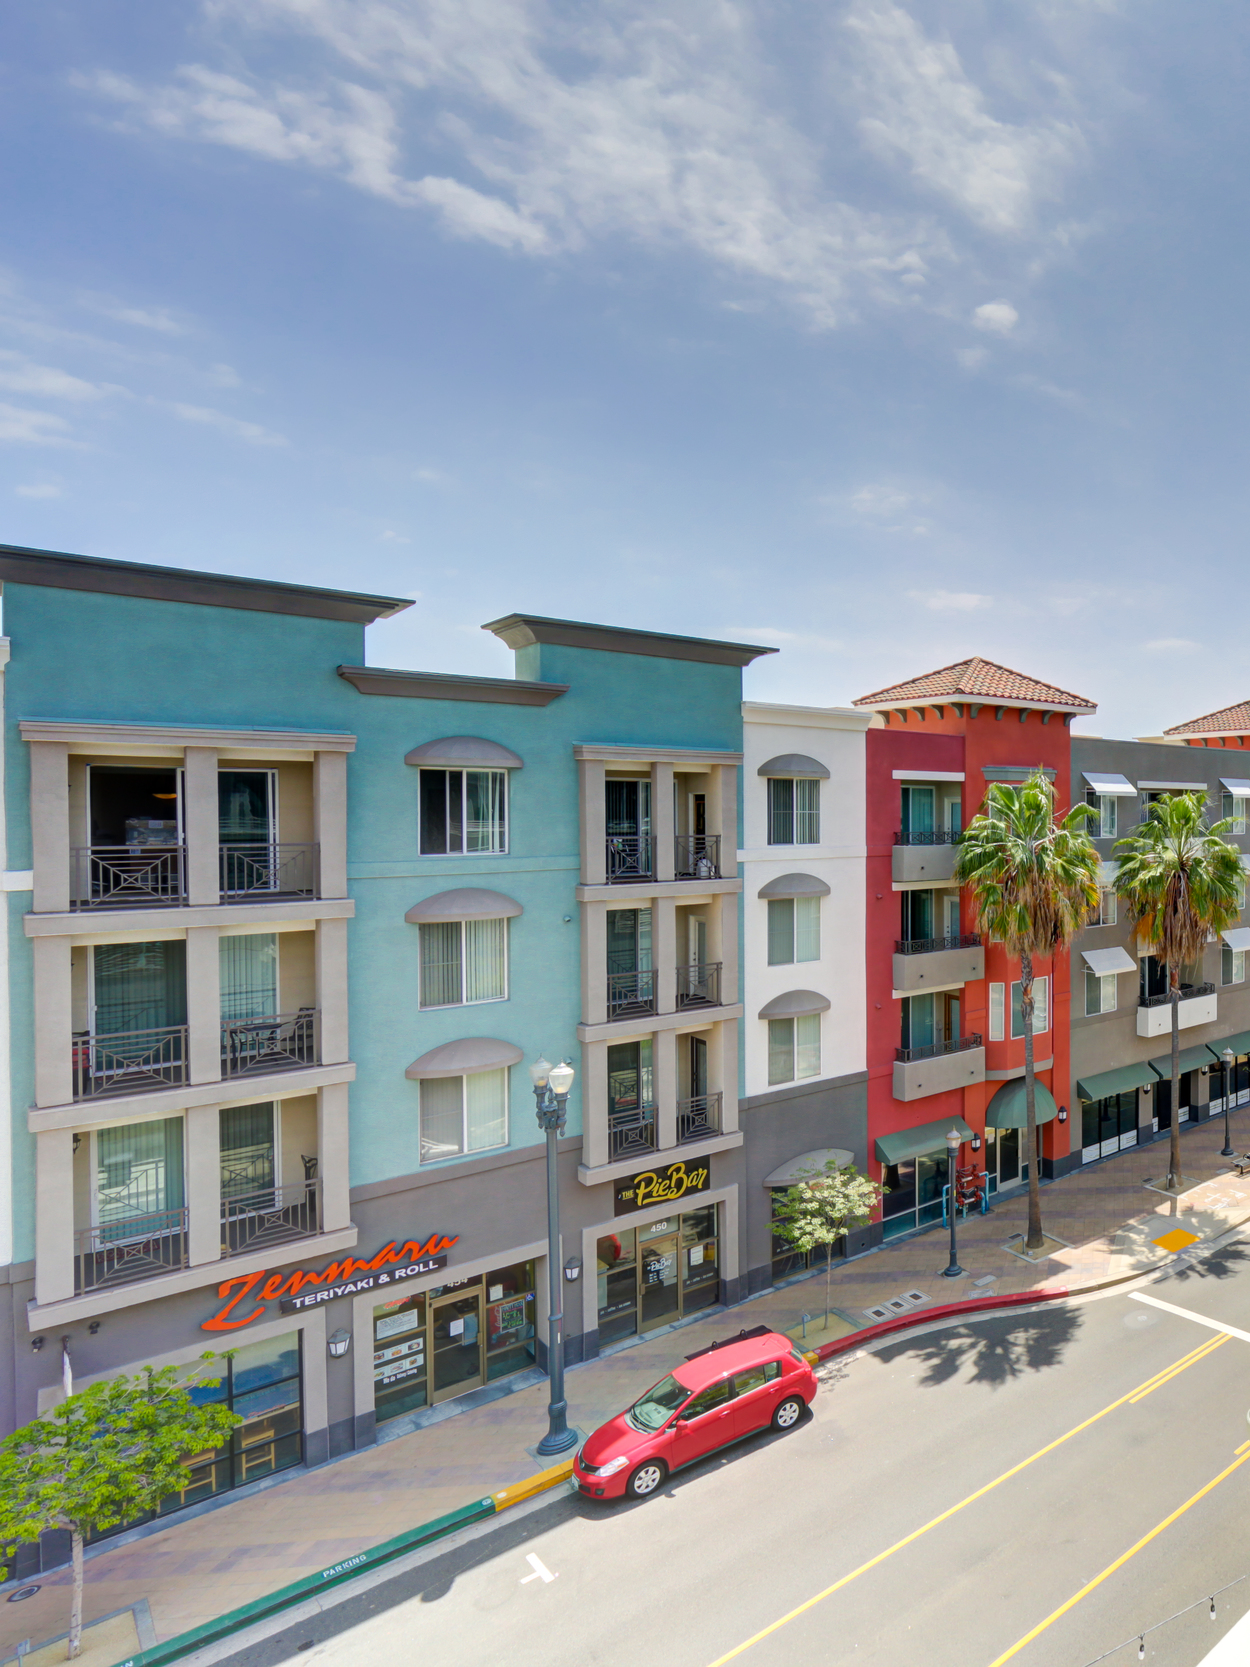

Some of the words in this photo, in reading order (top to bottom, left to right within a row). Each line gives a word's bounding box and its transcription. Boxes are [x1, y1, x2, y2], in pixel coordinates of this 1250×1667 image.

[622, 1189, 634, 1200] THE
[651, 1221, 667, 1233] 450
[201, 1234, 460, 1332] Zenmaru
[293, 1280, 374, 1309] TERIYAKI
[378, 1274, 391, 1284] &
[395, 1260, 439, 1279] ROLL
[323, 1555, 366, 1577] PARKING
